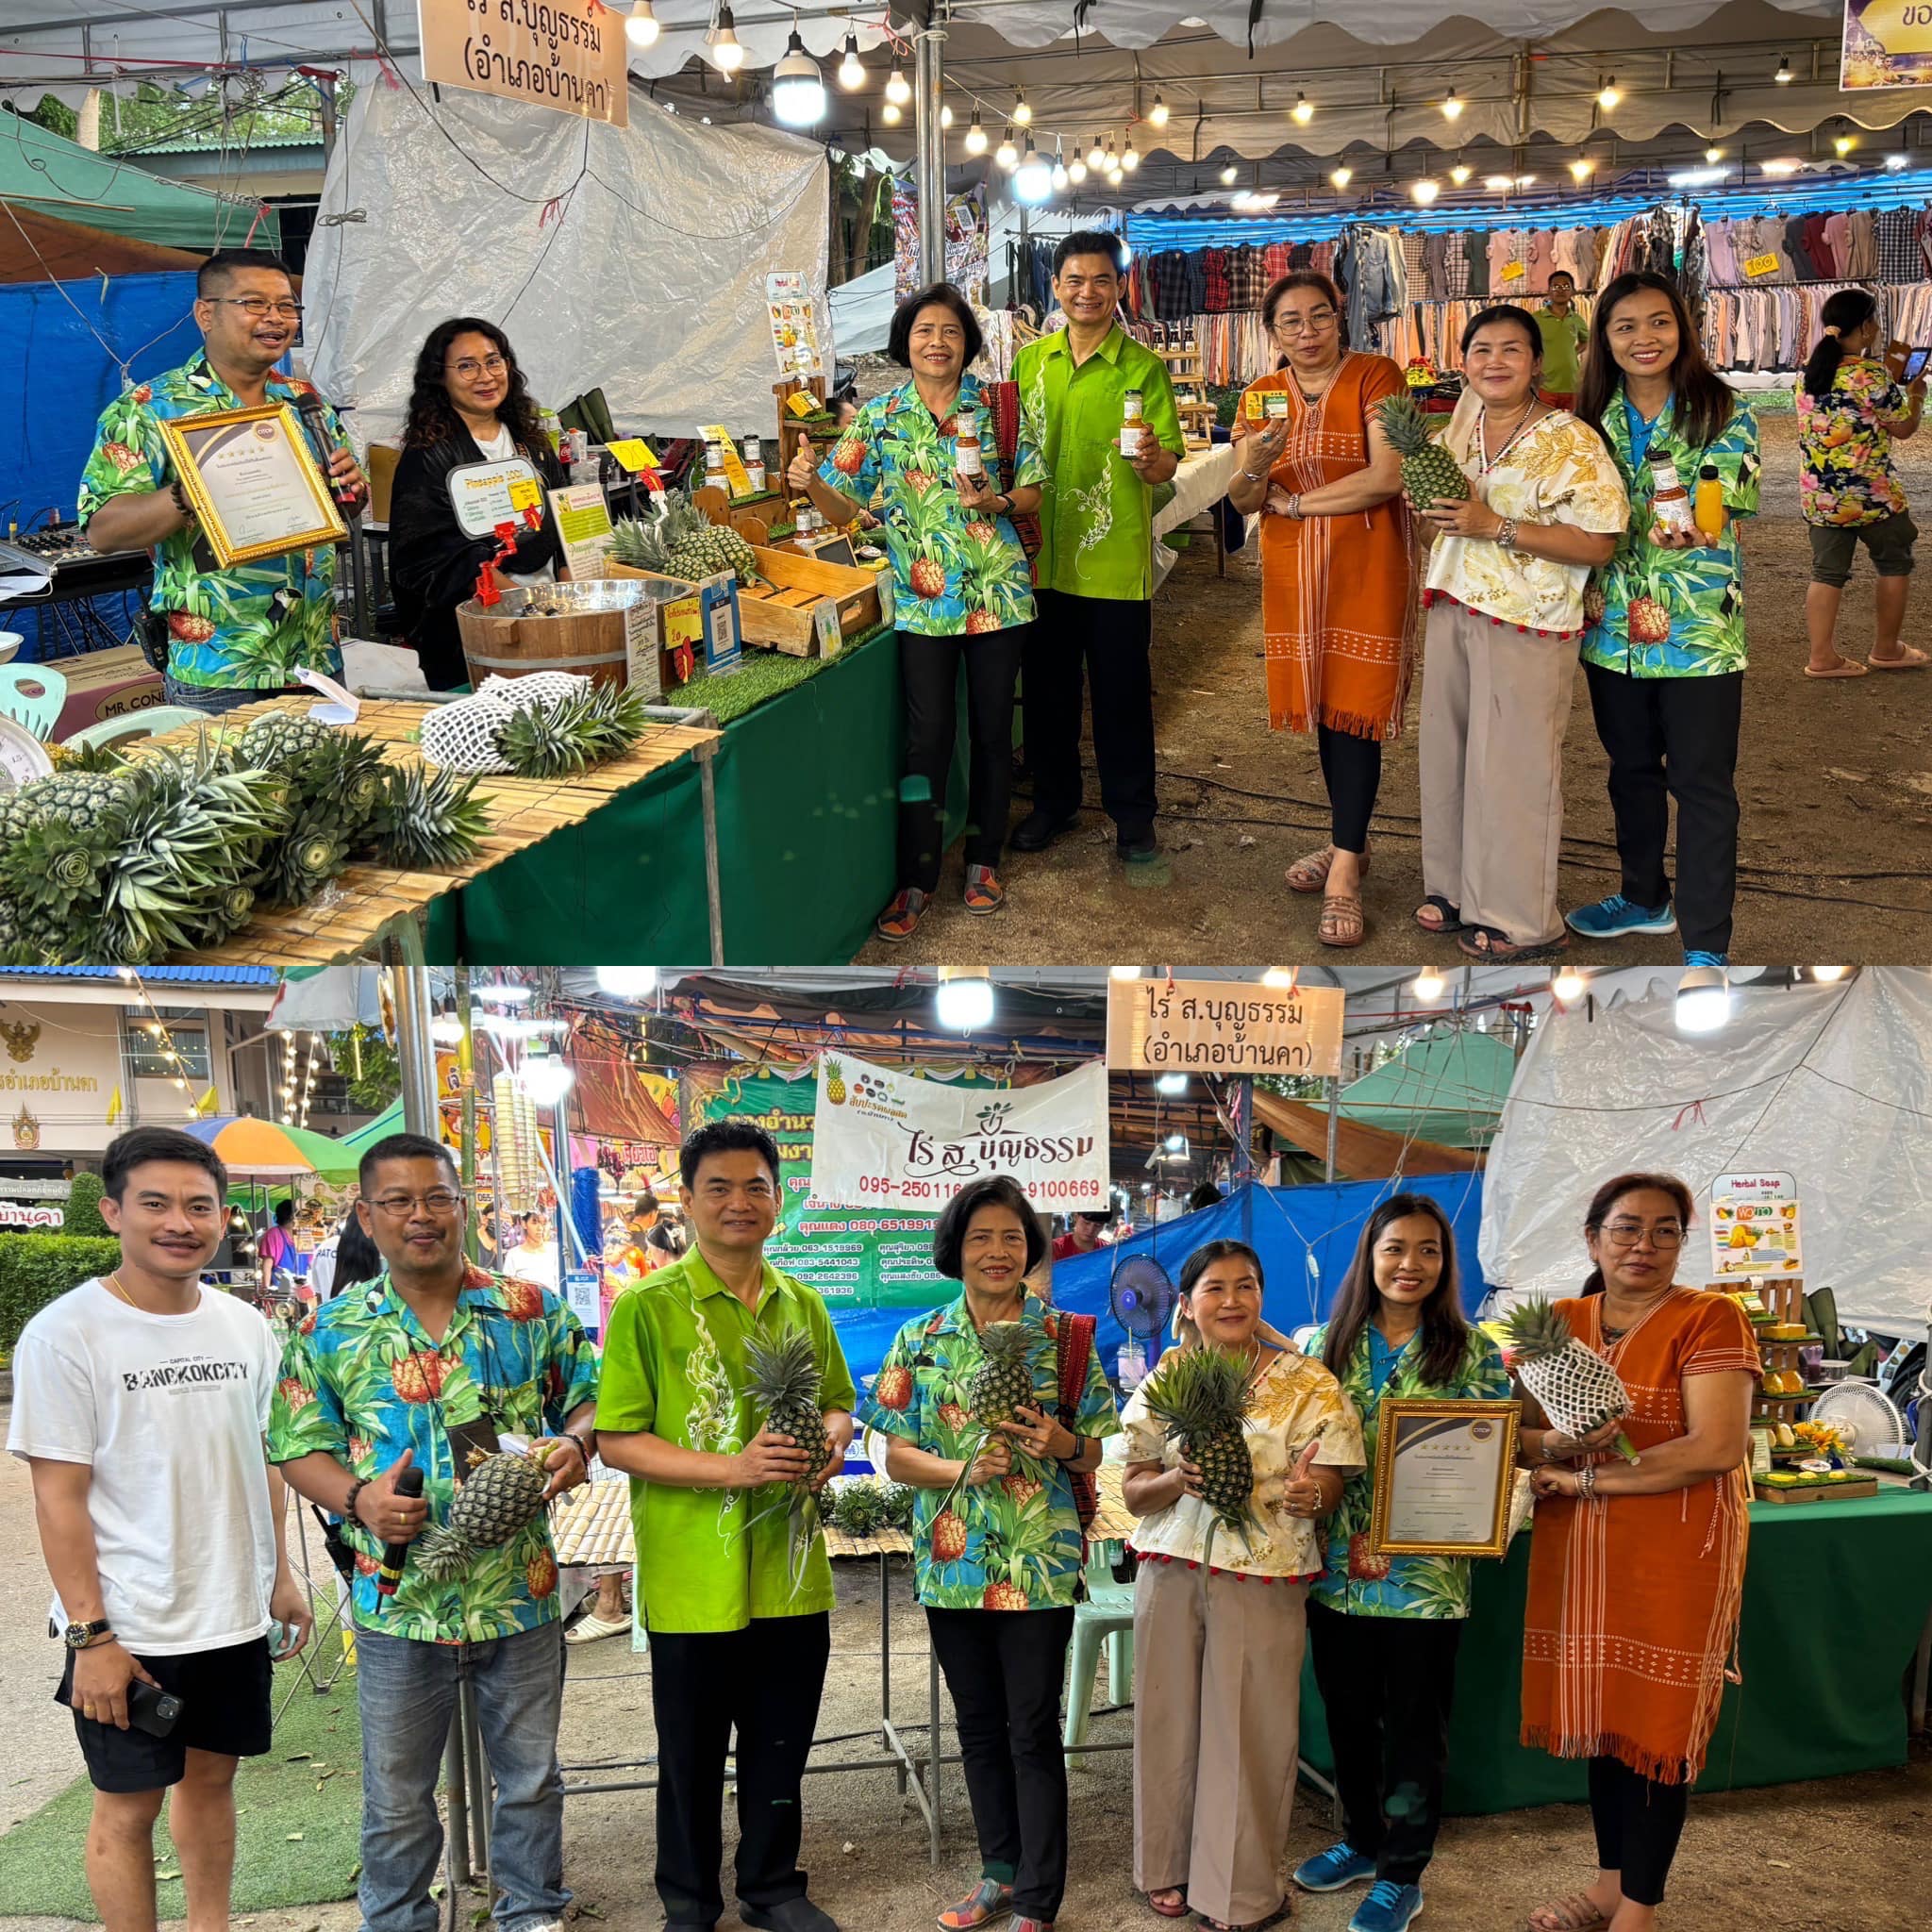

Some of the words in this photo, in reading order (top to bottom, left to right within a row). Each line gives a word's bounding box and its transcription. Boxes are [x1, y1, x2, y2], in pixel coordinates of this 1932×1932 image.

[1747, 256, 1774, 274] 100
[105, 702, 129, 717] MR.
[1731, 1178, 1757, 1189] Herbal
[1759, 1178, 1781, 1189] Soap
